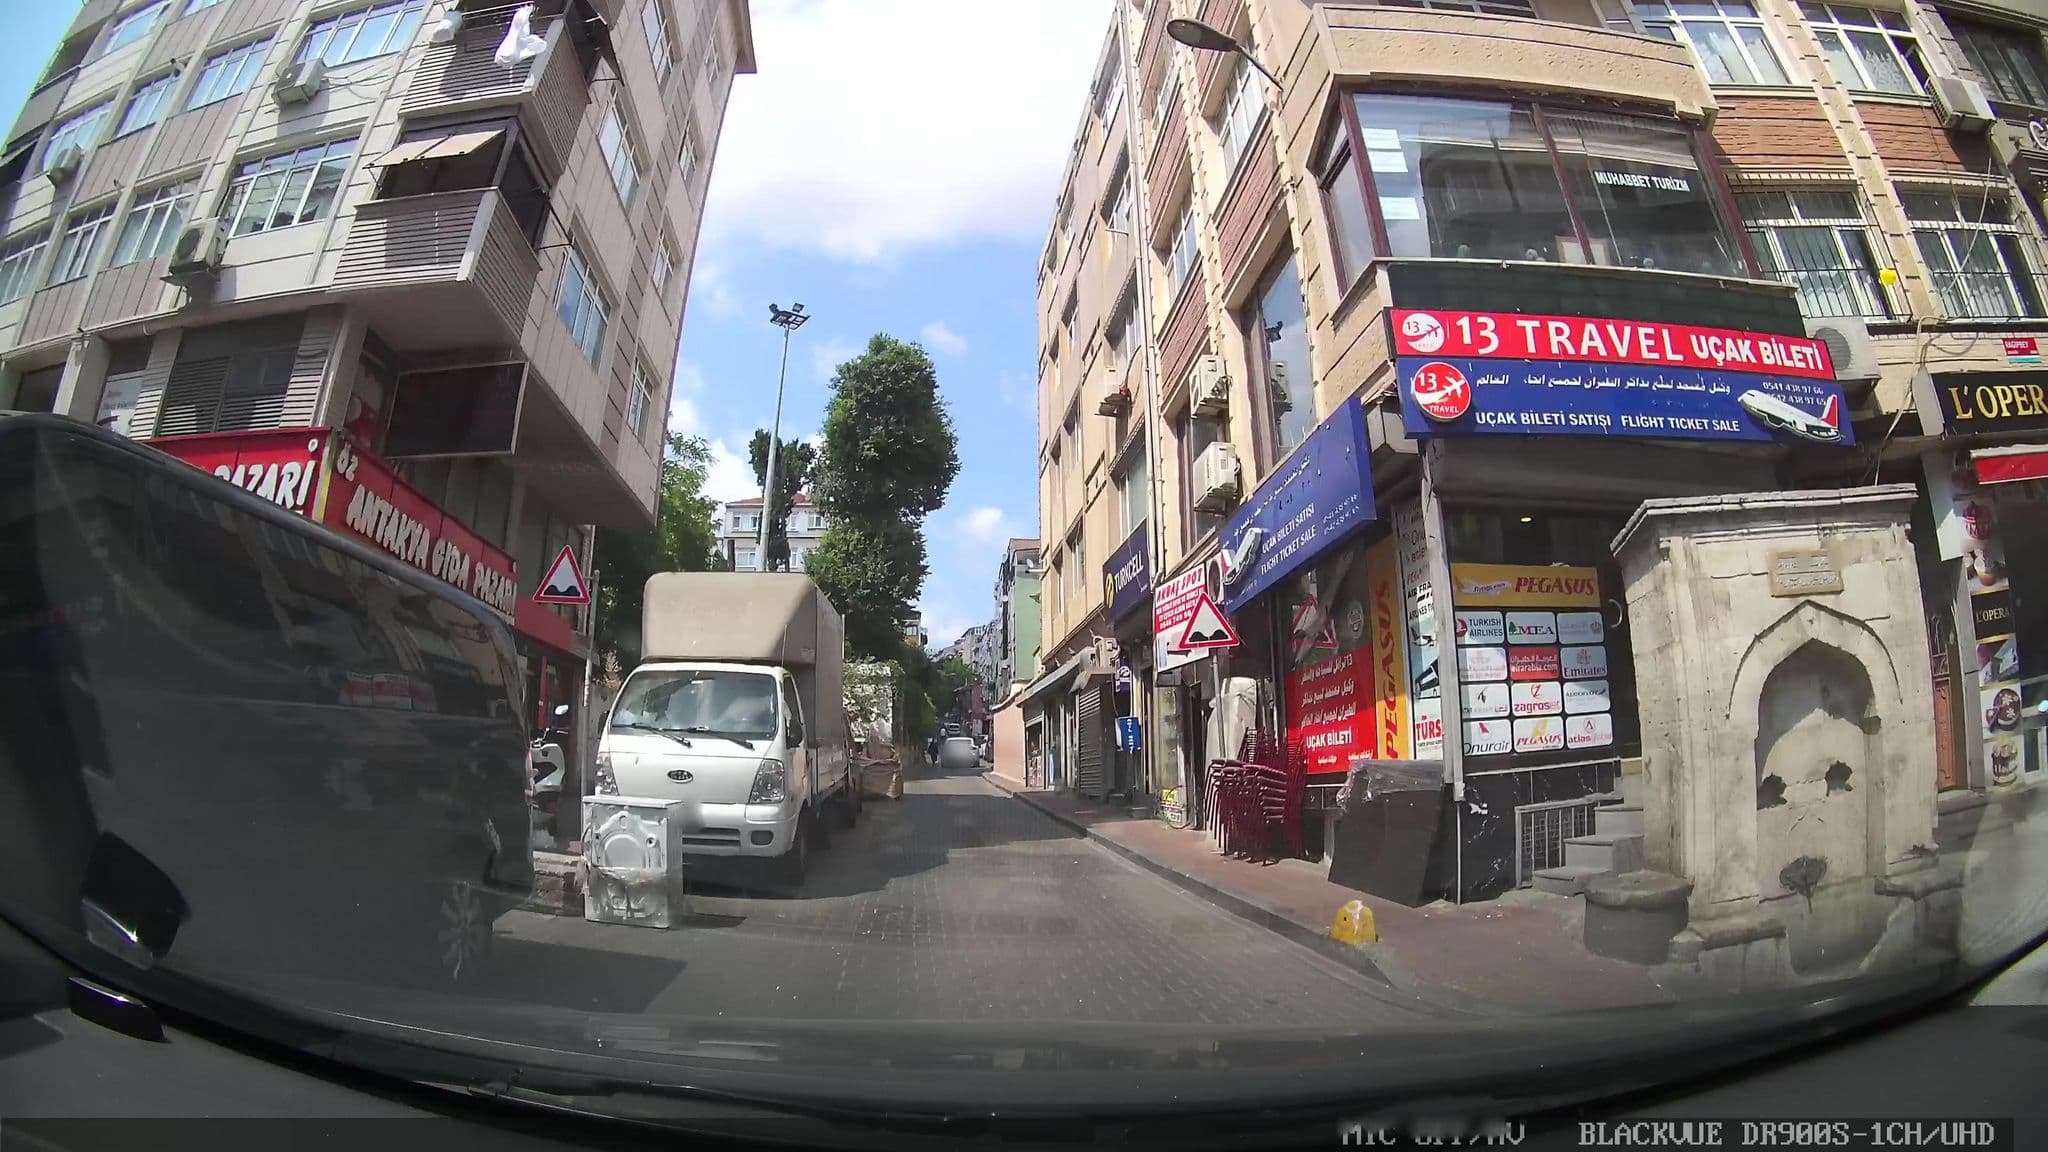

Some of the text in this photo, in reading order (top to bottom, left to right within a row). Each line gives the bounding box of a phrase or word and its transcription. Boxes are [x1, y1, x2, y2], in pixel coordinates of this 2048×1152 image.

[1594, 170, 1650, 190] MUHABBET
[1407, 321, 1420, 333] 13
[1456, 316, 1824, 371] 13 TRAVEL UÇAK BİLETİ
[1418, 372, 1437, 391] 13
[1429, 405, 1459, 413] TRAVEL
[1475, 409, 1741, 432] UÇAK BİLETİ SATIŞI FLIGHT TICKET SALE
[346, 483, 431, 570] ANTAKYA
[1261, 524, 1316, 576] FLIGHT TICKET SALE
[1114, 550, 1144, 593] TURKCELL
[1515, 576, 1595, 596] PEGASUS
[1469, 618, 1502, 628] TURKISH
[1469, 628, 1504, 638] AIRLINES
[1518, 626, 1555, 636] MEA
[1376, 577, 1399, 760] PEGASUS
[1564, 666, 1606, 678] Emirates
[1416, 715, 1445, 741] TÜRS
[1306, 726, 1352, 751] UÇAK BİLETİ
[1516, 735, 1561, 746] PEGASUS
